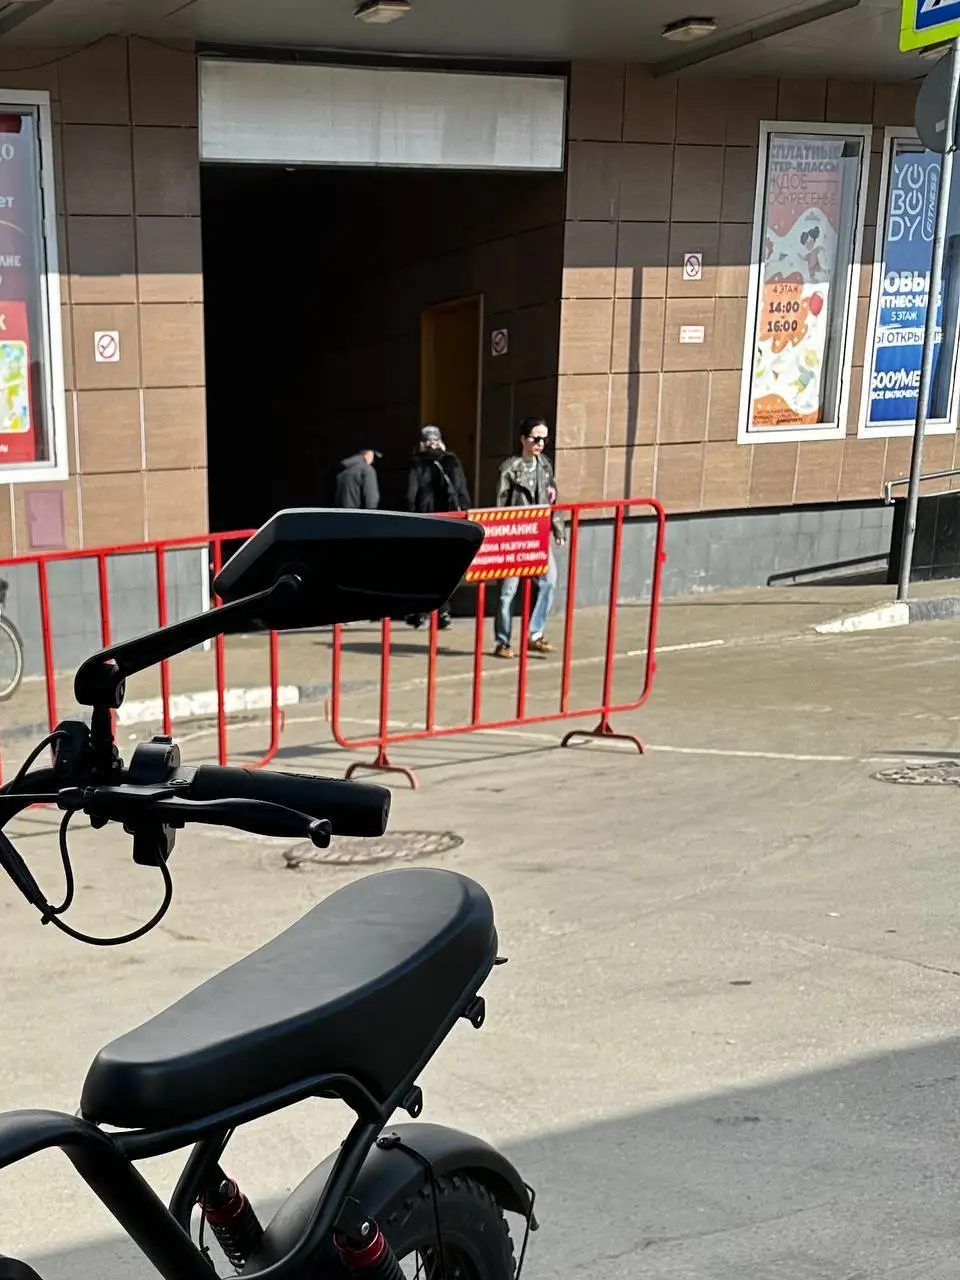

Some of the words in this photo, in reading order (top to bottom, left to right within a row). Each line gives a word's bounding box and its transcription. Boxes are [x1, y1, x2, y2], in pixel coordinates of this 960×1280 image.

[926, 171, 938, 233] FITNESS
[888, 216, 921, 241] DY
[769, 301, 800, 313] 14:00
[891, 311, 896, 320] 5
[897, 311, 917, 320] ЭТАЖ
[767, 319, 798, 332] 16:00
[484, 523, 539, 537] НИМАНИЕ
[506, 554, 515, 562] НЕ
